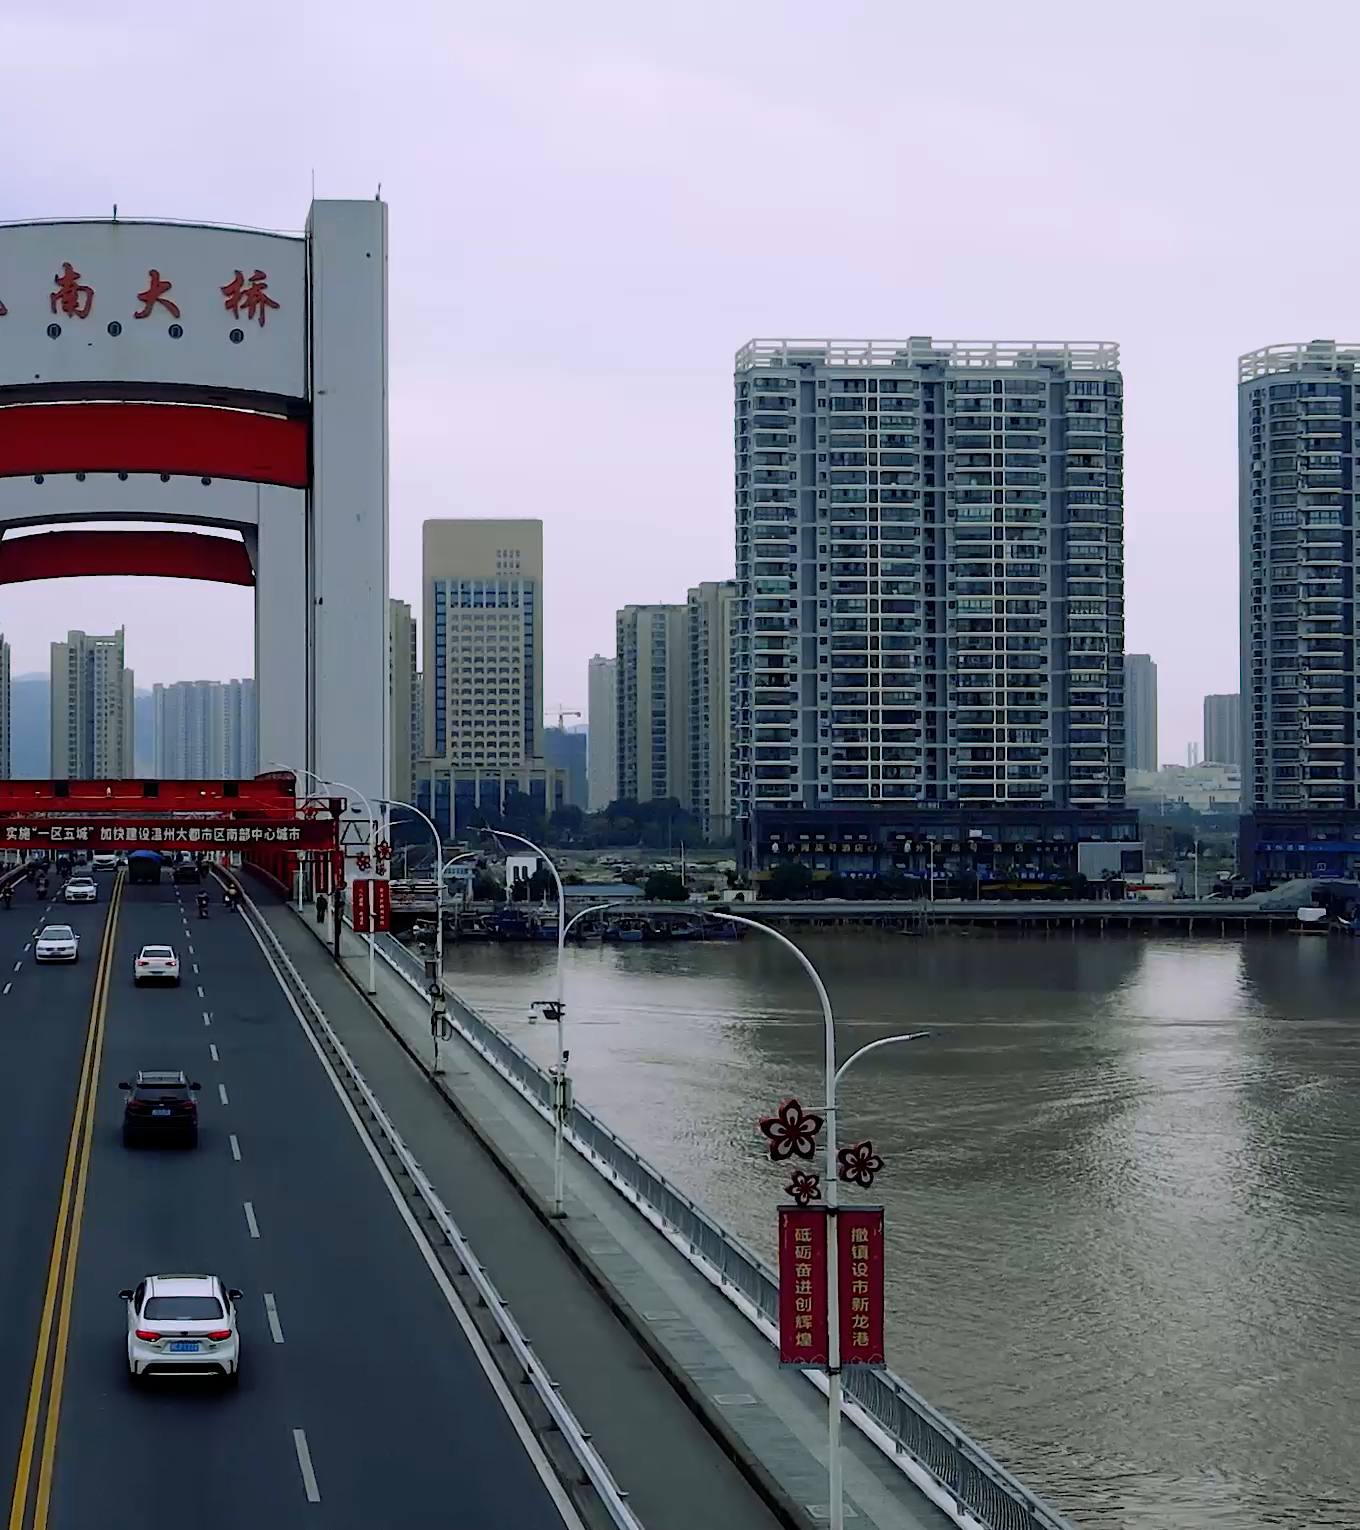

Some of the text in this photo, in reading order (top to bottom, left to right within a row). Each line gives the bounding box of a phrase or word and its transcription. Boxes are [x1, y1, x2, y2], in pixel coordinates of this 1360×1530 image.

[794, 1227, 813, 1347] 砥砺奋进创辉煌
[851, 1227, 870, 1347] 撤镇设市新龙港
